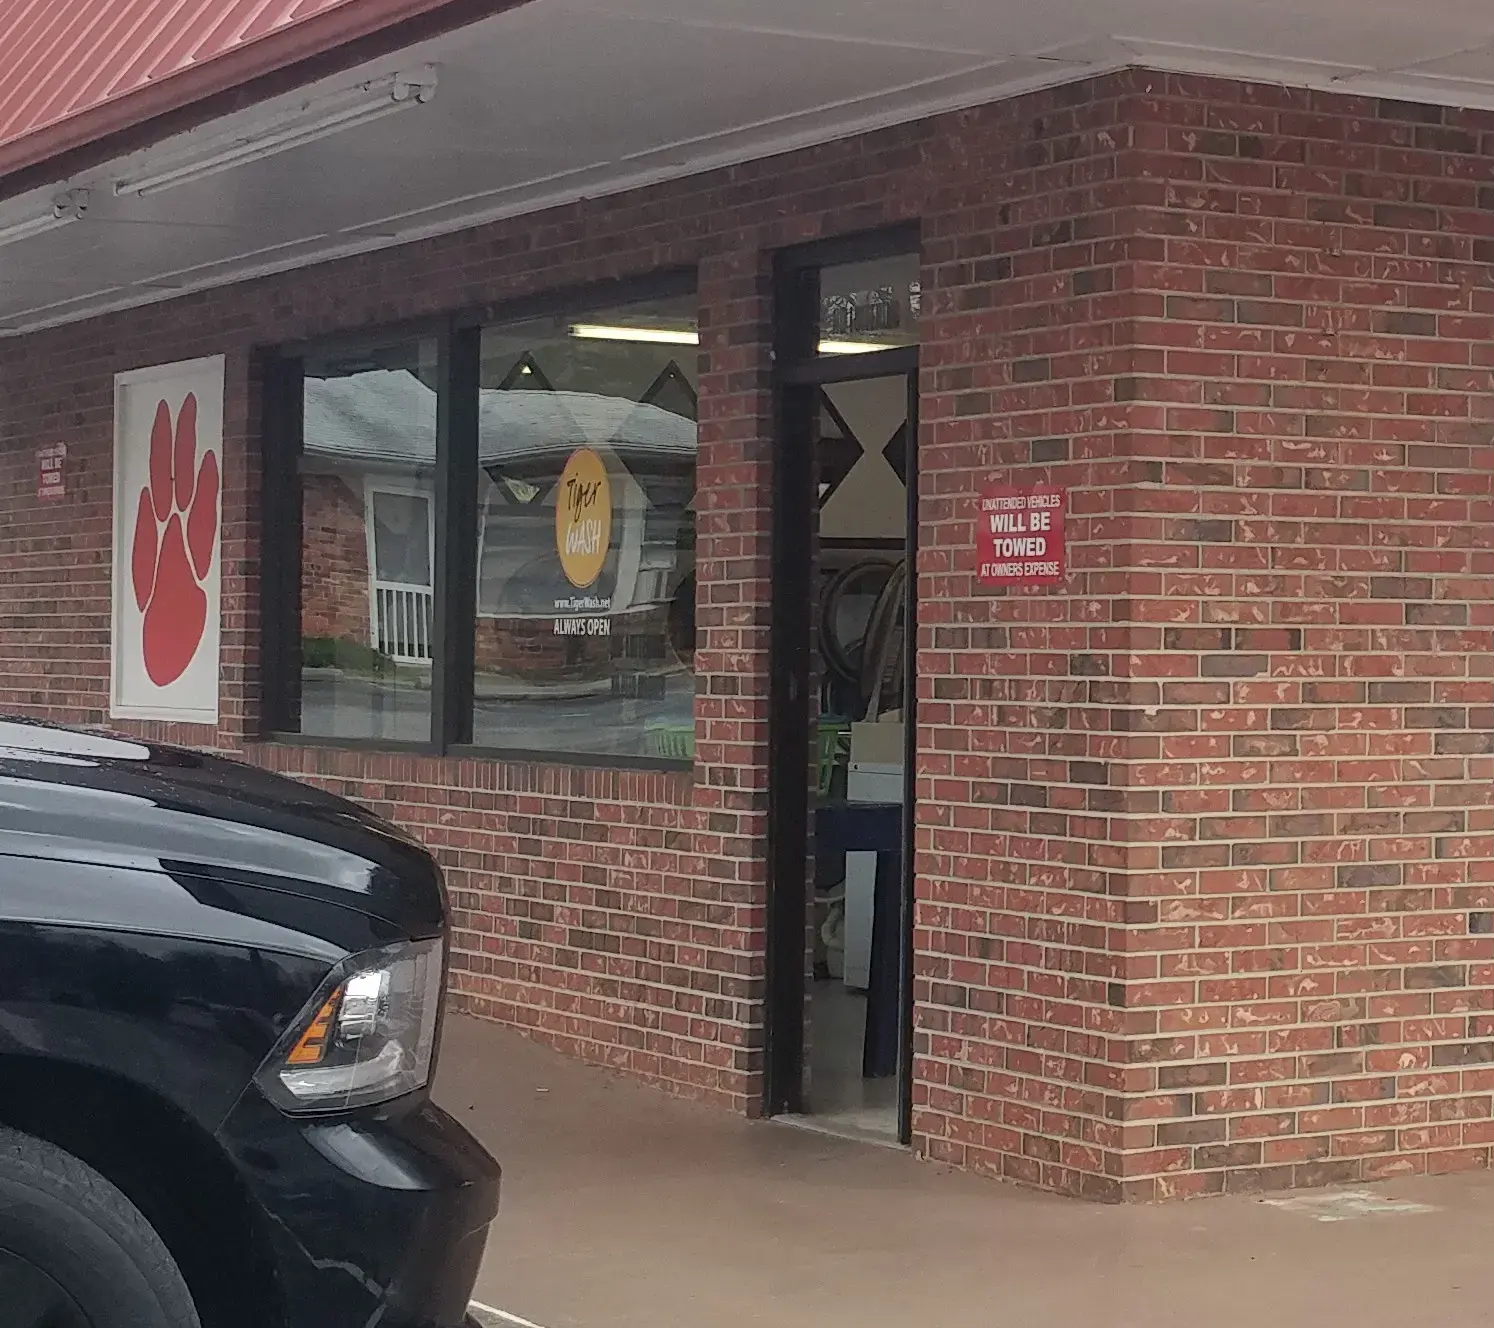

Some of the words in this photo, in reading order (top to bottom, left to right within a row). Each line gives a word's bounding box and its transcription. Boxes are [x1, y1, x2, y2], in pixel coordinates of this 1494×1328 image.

[567, 472, 601, 523] Tiger
[982, 496, 1026, 511] UNATTENDED
[1027, 495, 1061, 509] VEHICLES
[990, 514, 1026, 532] WILL
[1030, 512, 1050, 531] BE
[566, 520, 601, 555] WASH
[993, 537, 1046, 557] TOWED
[981, 563, 991, 577] AT
[991, 562, 1023, 576] OWNERS
[1024, 562, 1059, 576] EXPENSE
[554, 619, 586, 635] ALWAYS
[587, 619, 611, 635] OPEN
